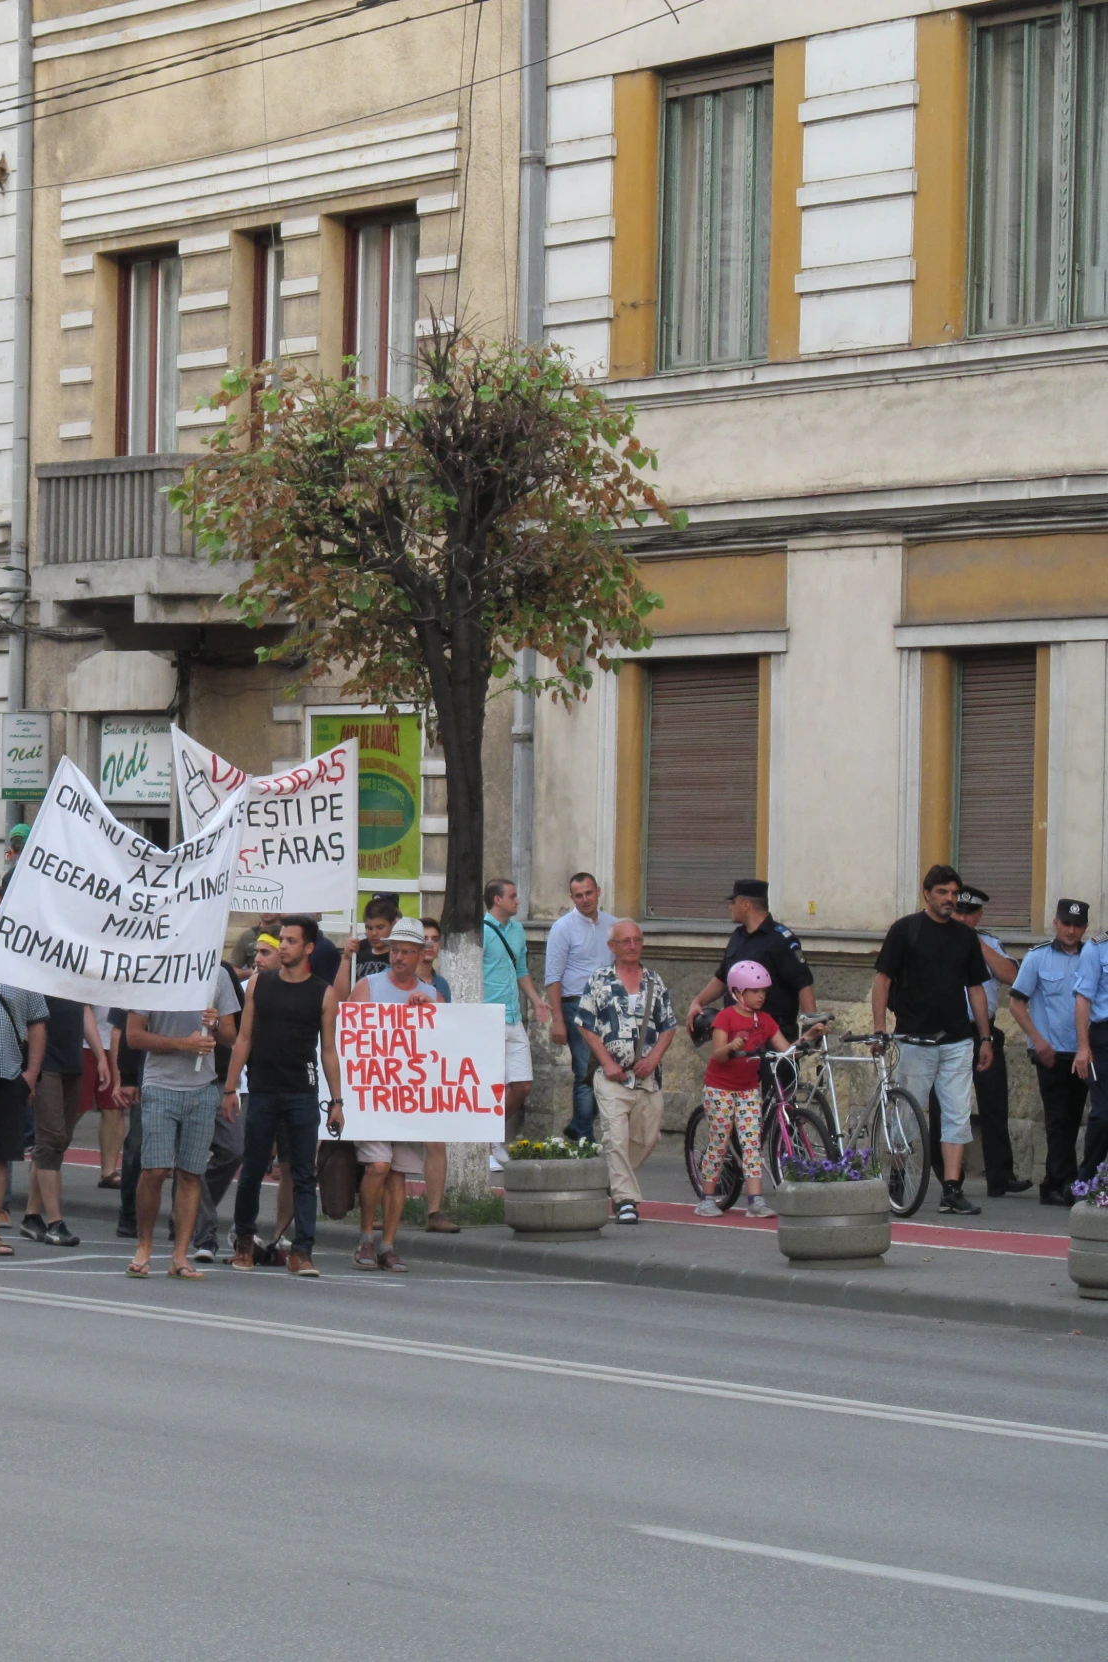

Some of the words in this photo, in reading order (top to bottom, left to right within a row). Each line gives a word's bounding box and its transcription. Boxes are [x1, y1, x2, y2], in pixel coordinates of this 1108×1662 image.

[103, 723, 127, 736] Salon
[130, 724, 139, 734] de
[371, 724, 400, 756] AMANET
[7, 744, 43, 763] Ildi
[102, 739, 149, 796] Ildi
[55, 784, 96, 824] CINE
[99, 817, 126, 847] NU
[127, 836, 158, 863] SE
[311, 793, 344, 825] PE
[261, 832, 345, 867] FĂRAȘ
[383, 846, 402, 869] STOP
[28, 845, 123, 907] DEGEABA
[129, 891, 159, 915] SE
[127, 863, 184, 889] AZI
[336, 1003, 437, 1029] REMIER
[441, 1056, 480, 1087] LA
[351, 1083, 506, 1117] TRIBUNAL!
